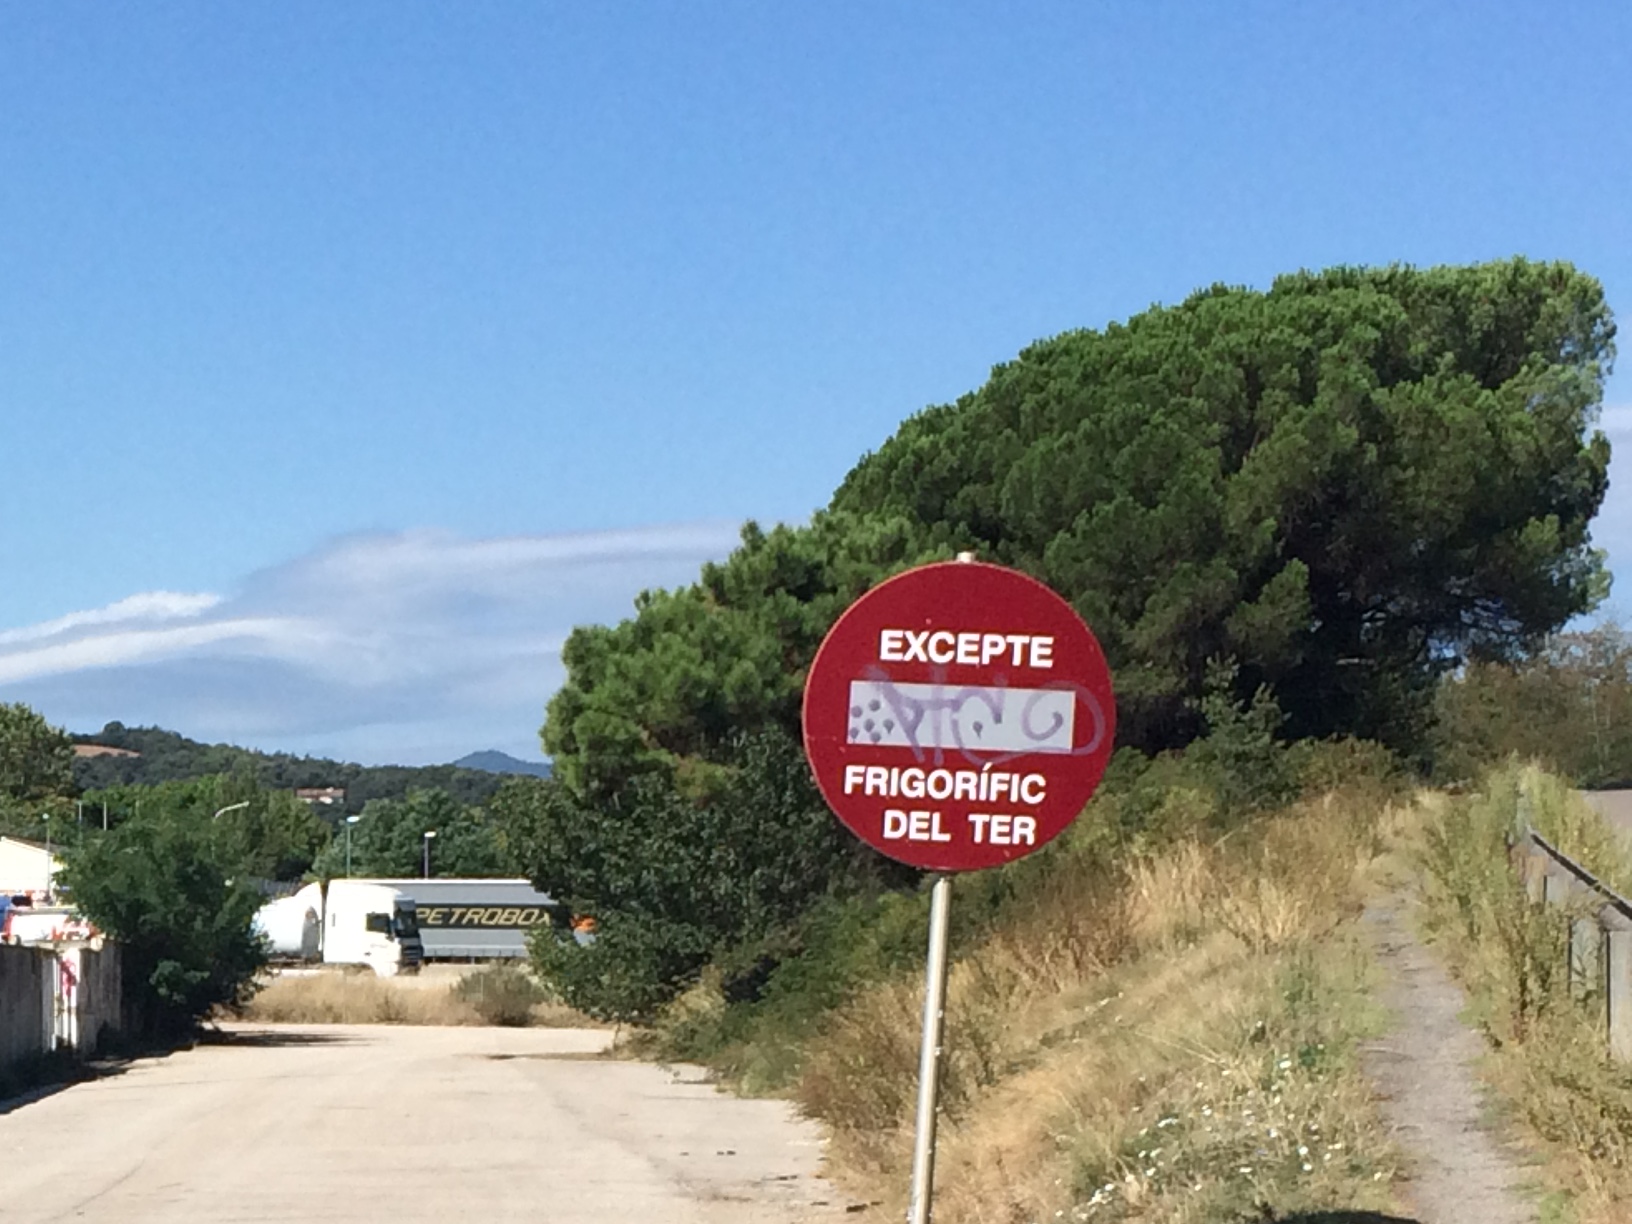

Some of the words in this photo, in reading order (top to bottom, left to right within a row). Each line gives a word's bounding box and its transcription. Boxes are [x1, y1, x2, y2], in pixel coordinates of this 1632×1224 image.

[879, 629, 1055, 669] EXCEPTE
[843, 762, 1048, 804] FRIGORÍFIC
[882, 809, 952, 843] DEL
[967, 813, 1037, 846] TER
